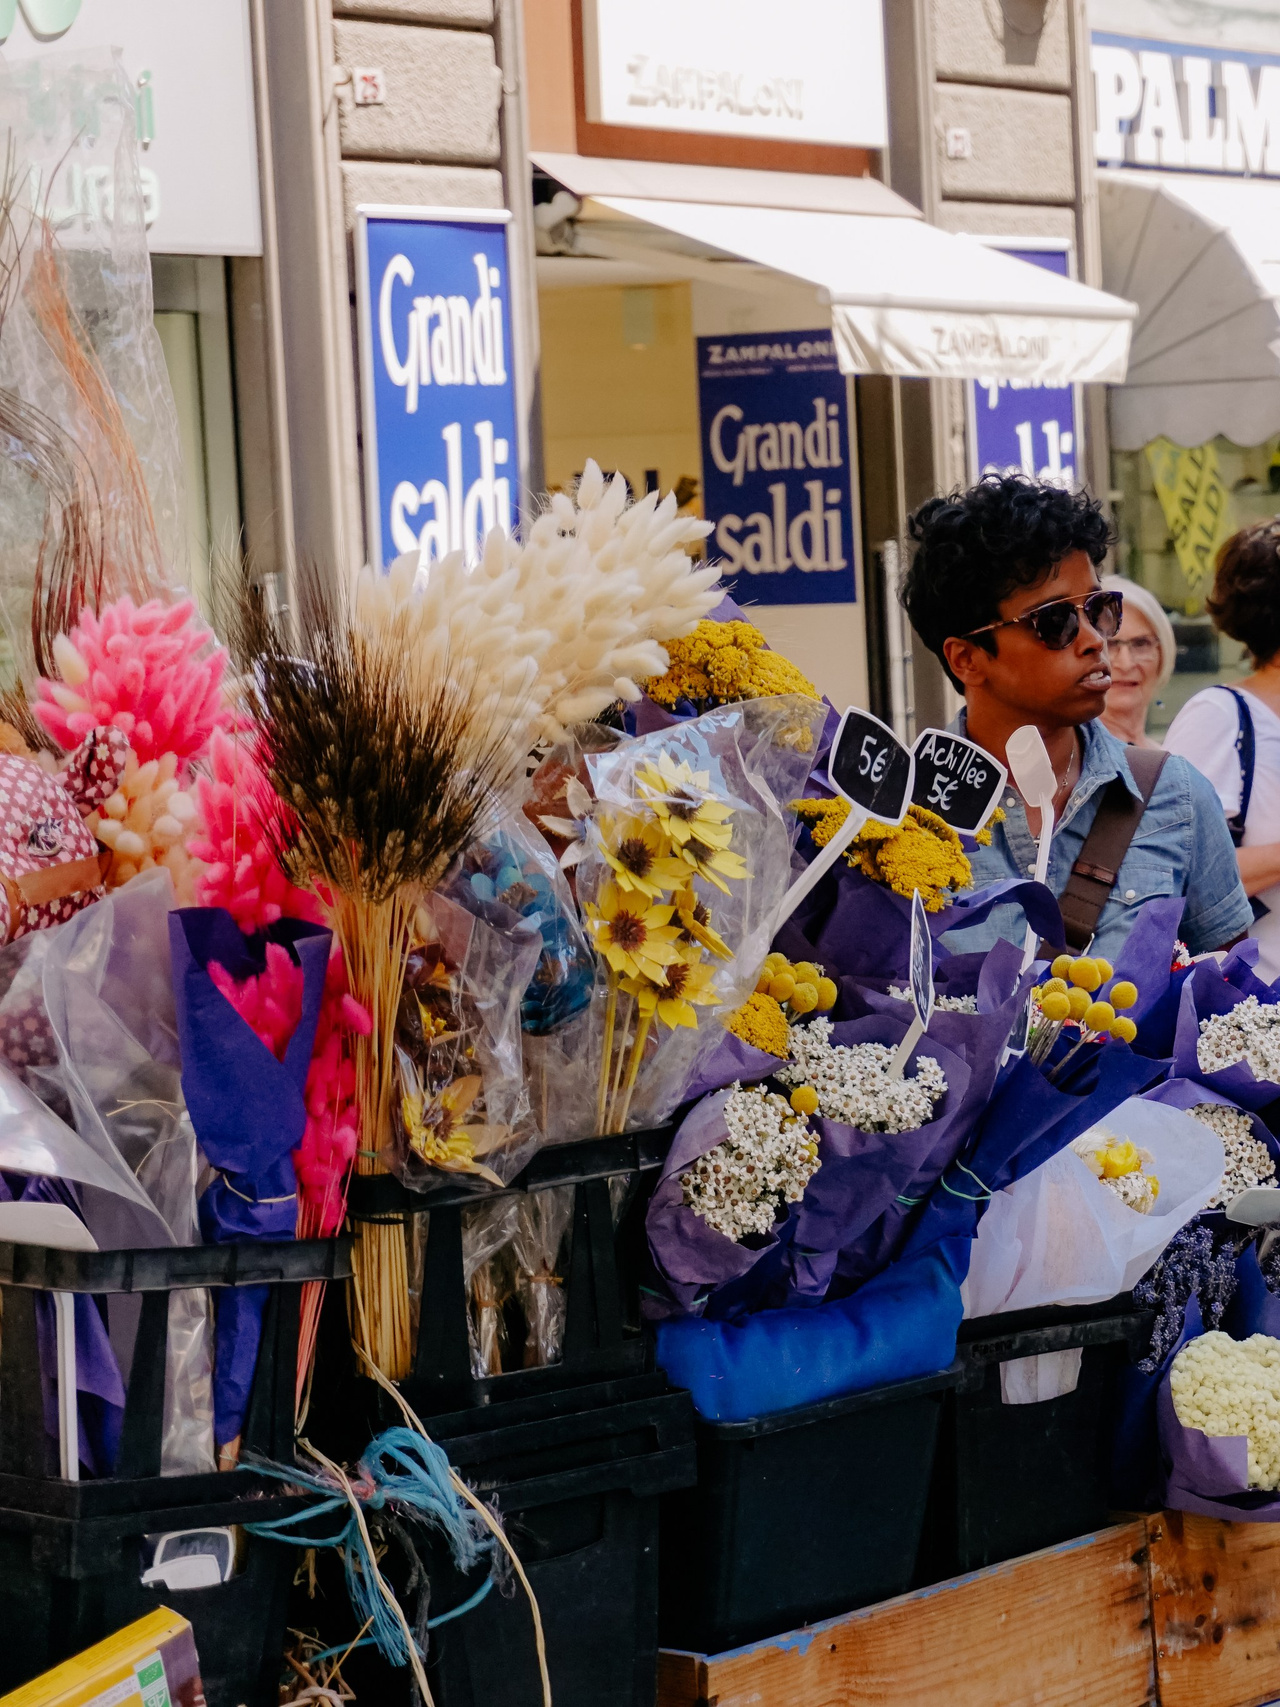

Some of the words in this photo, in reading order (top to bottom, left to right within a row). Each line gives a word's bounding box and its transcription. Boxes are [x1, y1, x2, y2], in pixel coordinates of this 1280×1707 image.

[380, 253, 507, 414] Grandi
[931, 327, 1050, 361] ZAMPALONI
[709, 397, 843, 487] Grandi
[391, 421, 510, 576] saldi
[716, 479, 847, 577] saldi
[858, 735, 888, 783] 5€
[919, 733, 988, 789] Achillée
[927, 772, 959, 811] 5€
